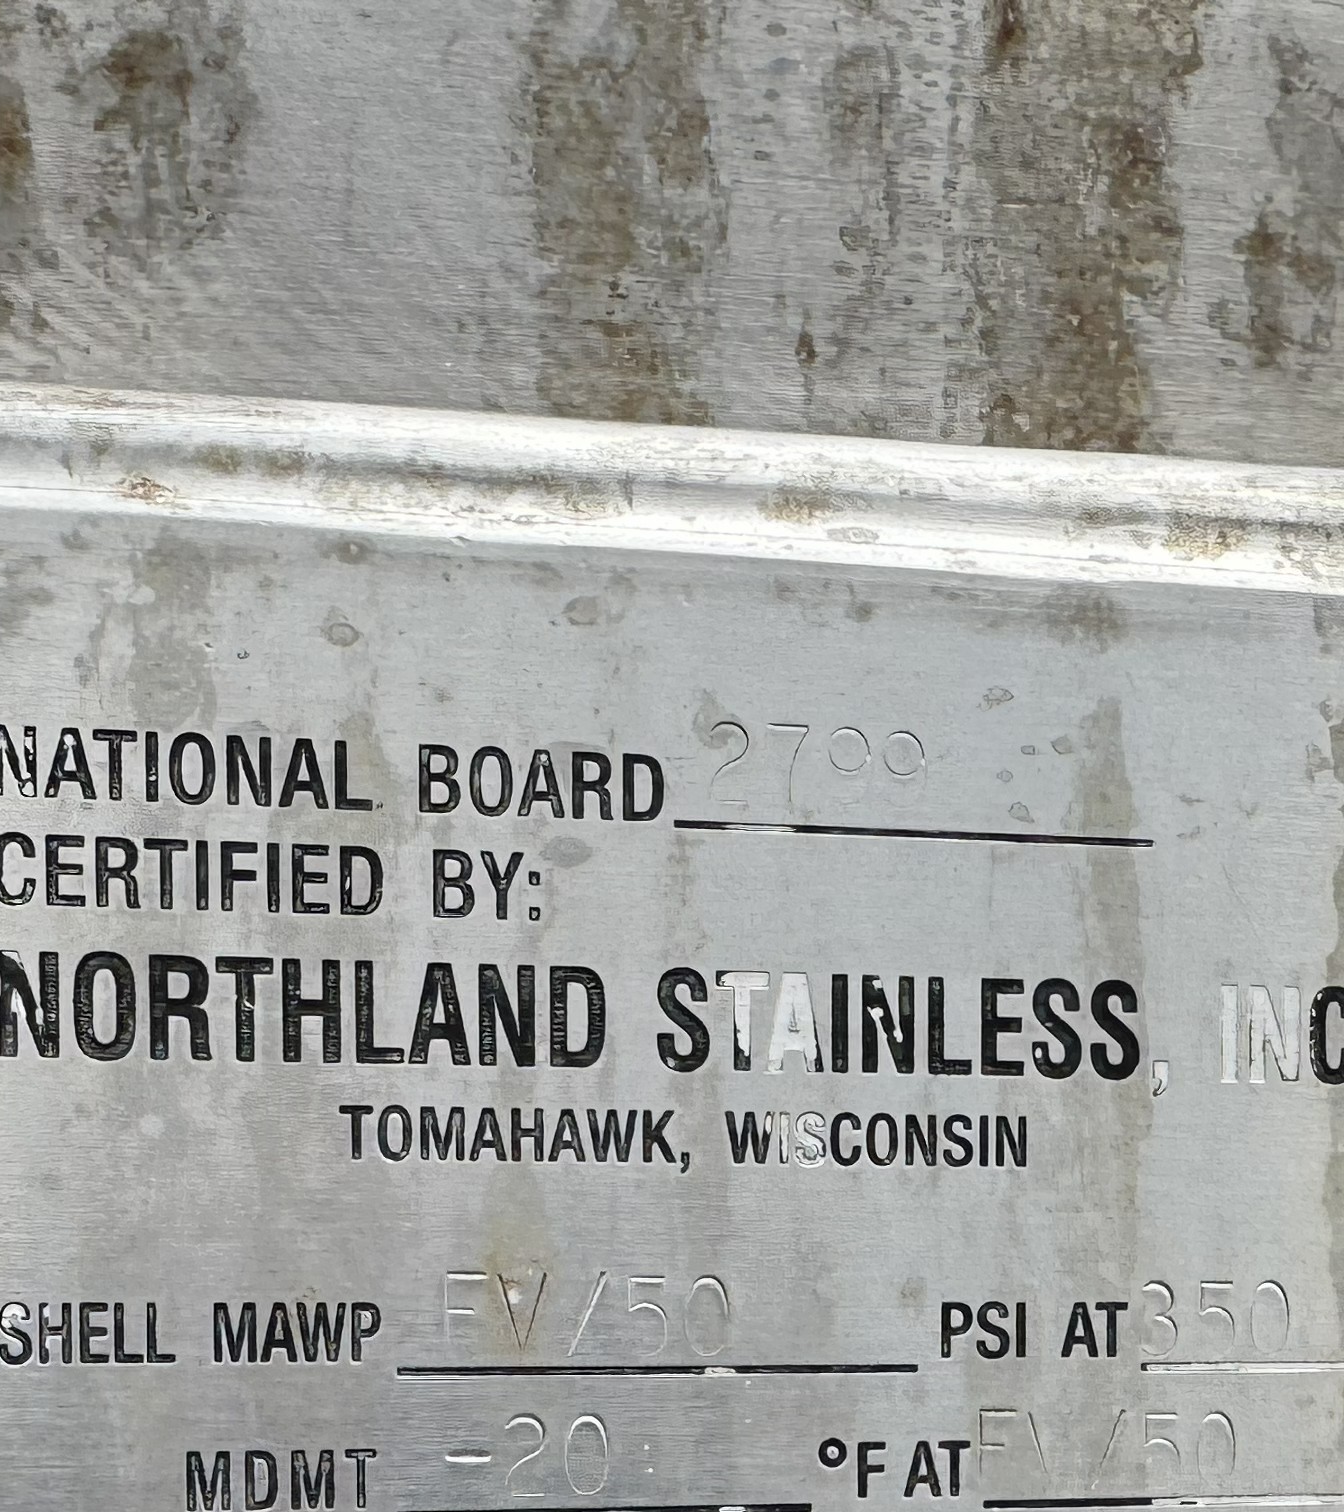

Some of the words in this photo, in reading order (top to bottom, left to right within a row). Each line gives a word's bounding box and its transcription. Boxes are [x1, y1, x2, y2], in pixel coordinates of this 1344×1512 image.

[417, 744, 666, 822] BOARD
[432, 849, 542, 922] BY:
[656, 967, 1170, 1097] STAINLESS,
[339, 1105, 691, 1174] TOMAHAWK,
[724, 1110, 1029, 1169] WISCONSIN
[212, 1301, 383, 1363] MAWP
[444, 1271, 731, 1357] FV/50
[939, 1300, 1027, 1360] PSI
[1060, 1300, 1129, 1360] AT
[1142, 1279, 1291, 1358] 350
[185, 1447, 377, 1512] MDMT
[444, 1414, 610, 1498] -20
[818, 1436, 886, 1500] °F
[904, 1440, 971, 1498] AT
